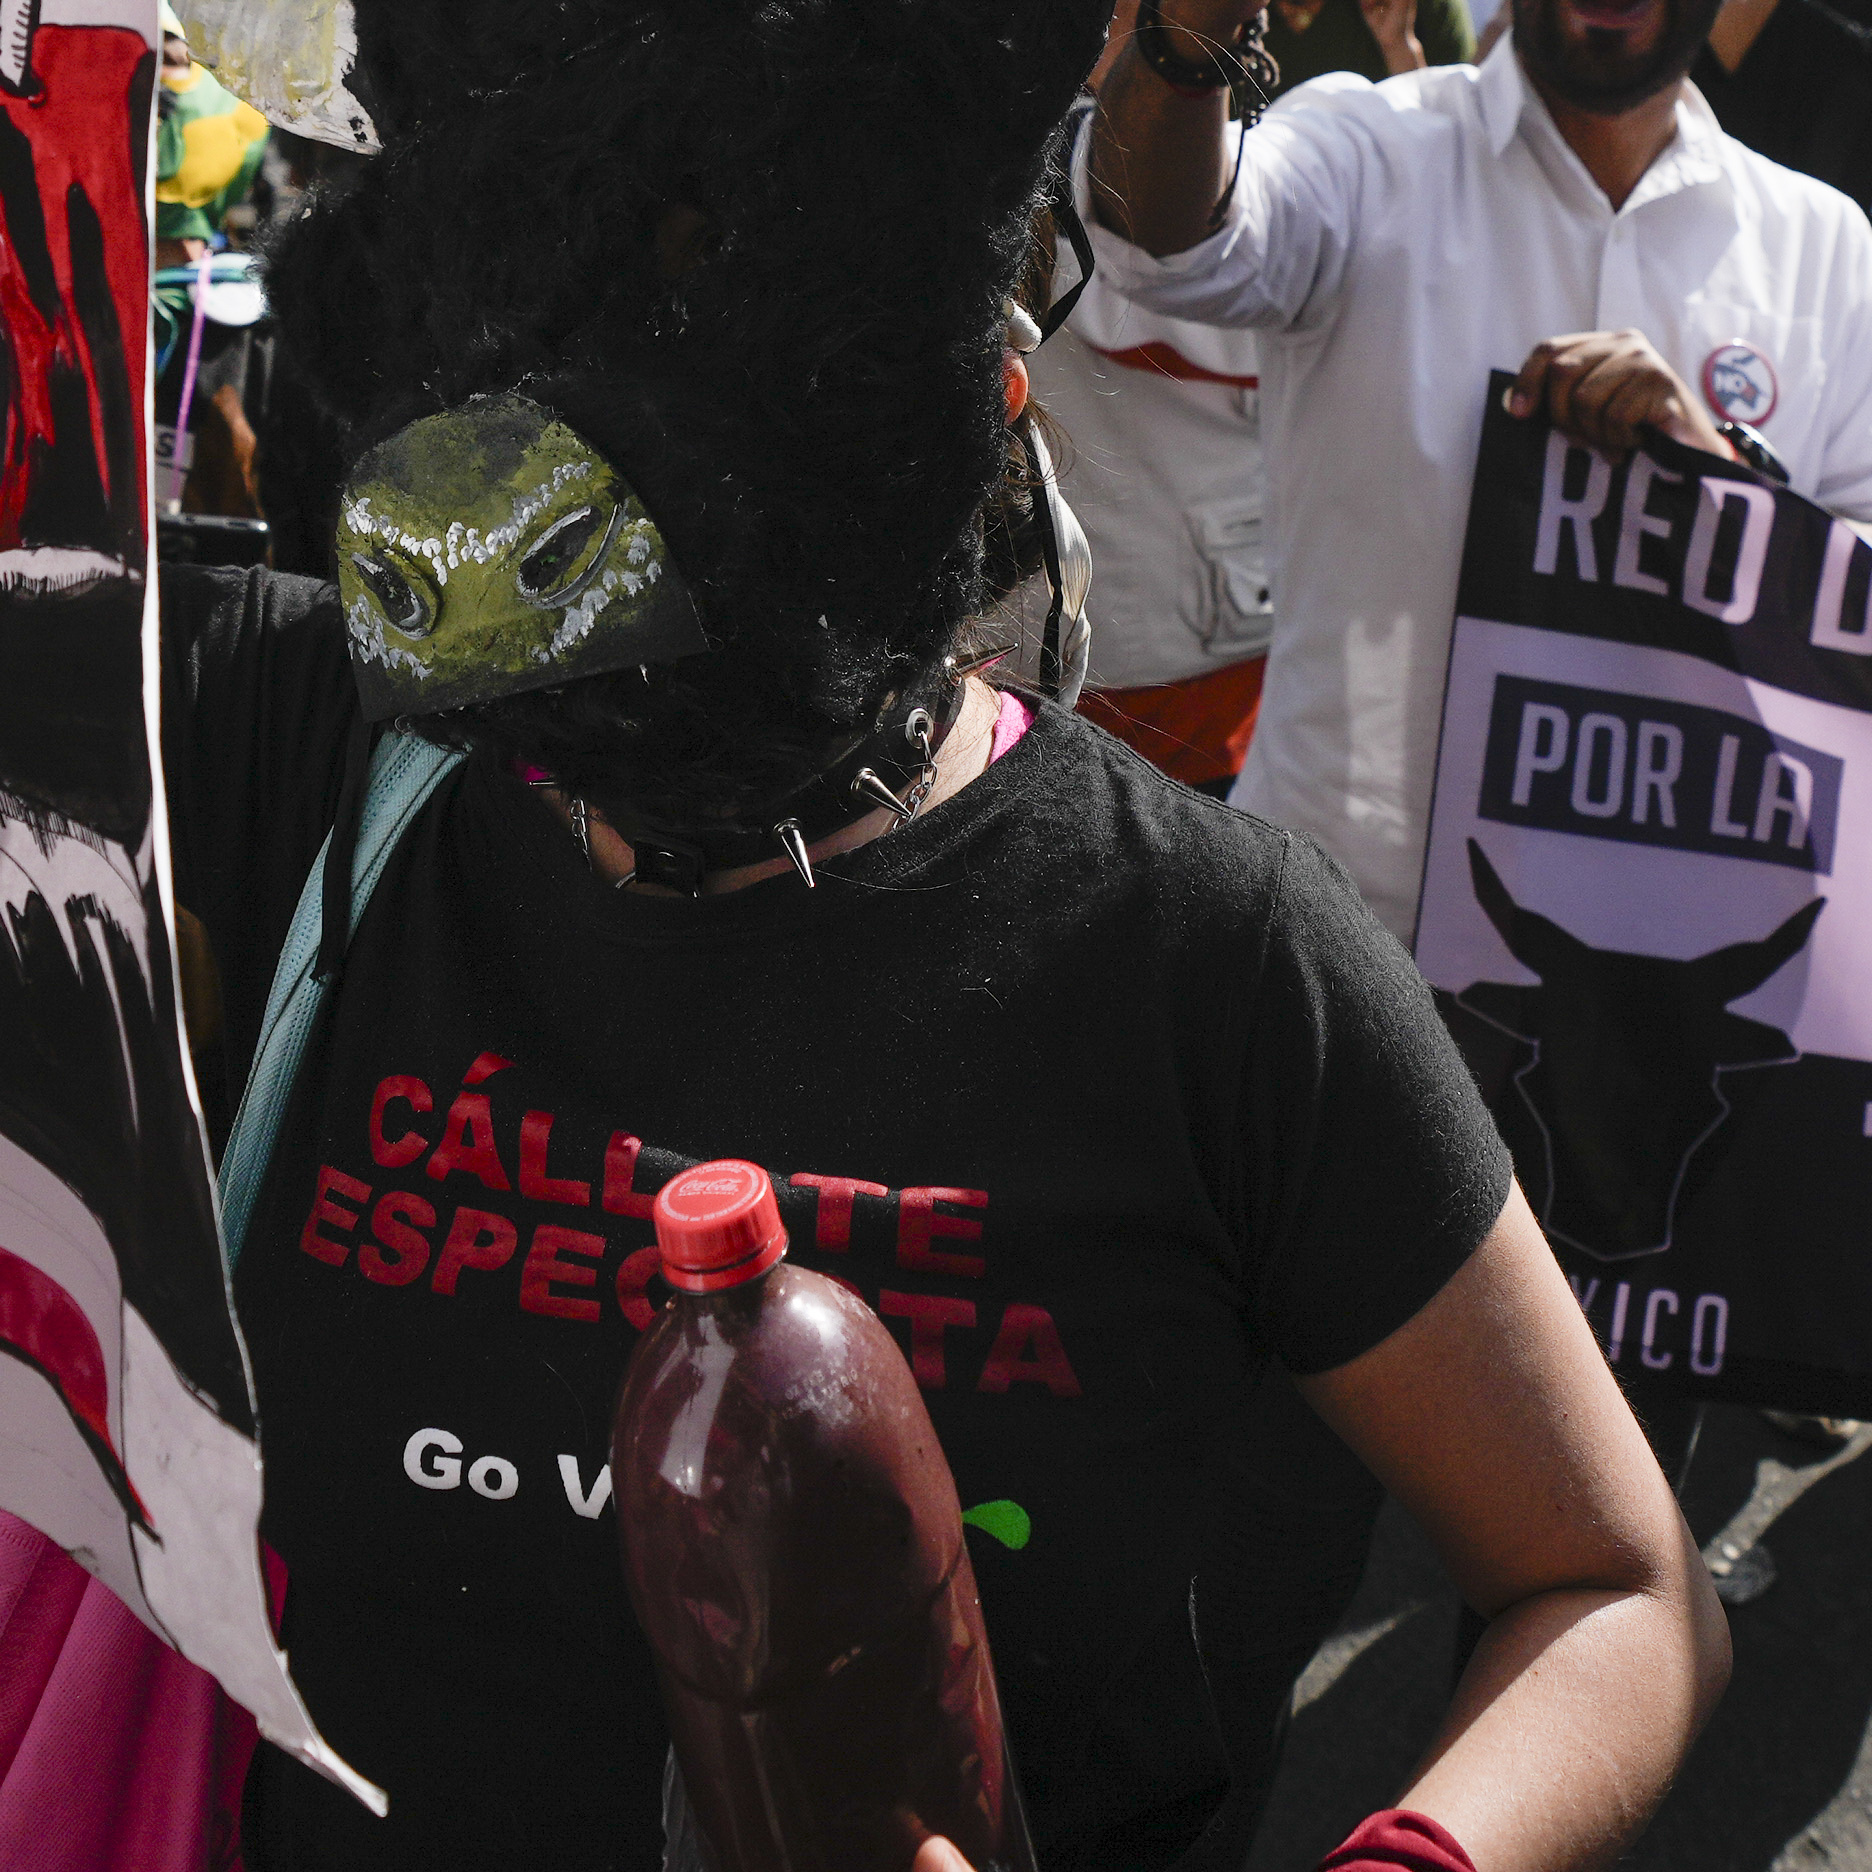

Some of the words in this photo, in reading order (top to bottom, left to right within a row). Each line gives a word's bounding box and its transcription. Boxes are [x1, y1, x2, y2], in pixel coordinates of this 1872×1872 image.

[1532, 425, 1776, 625] RED
[1510, 699, 1680, 829] POR
[1709, 723, 1815, 852] LA
[368, 1050, 989, 1280] CÁLLTE
[297, 1164, 1083, 1400] ESPECTA
[402, 1426, 520, 1501] Go
